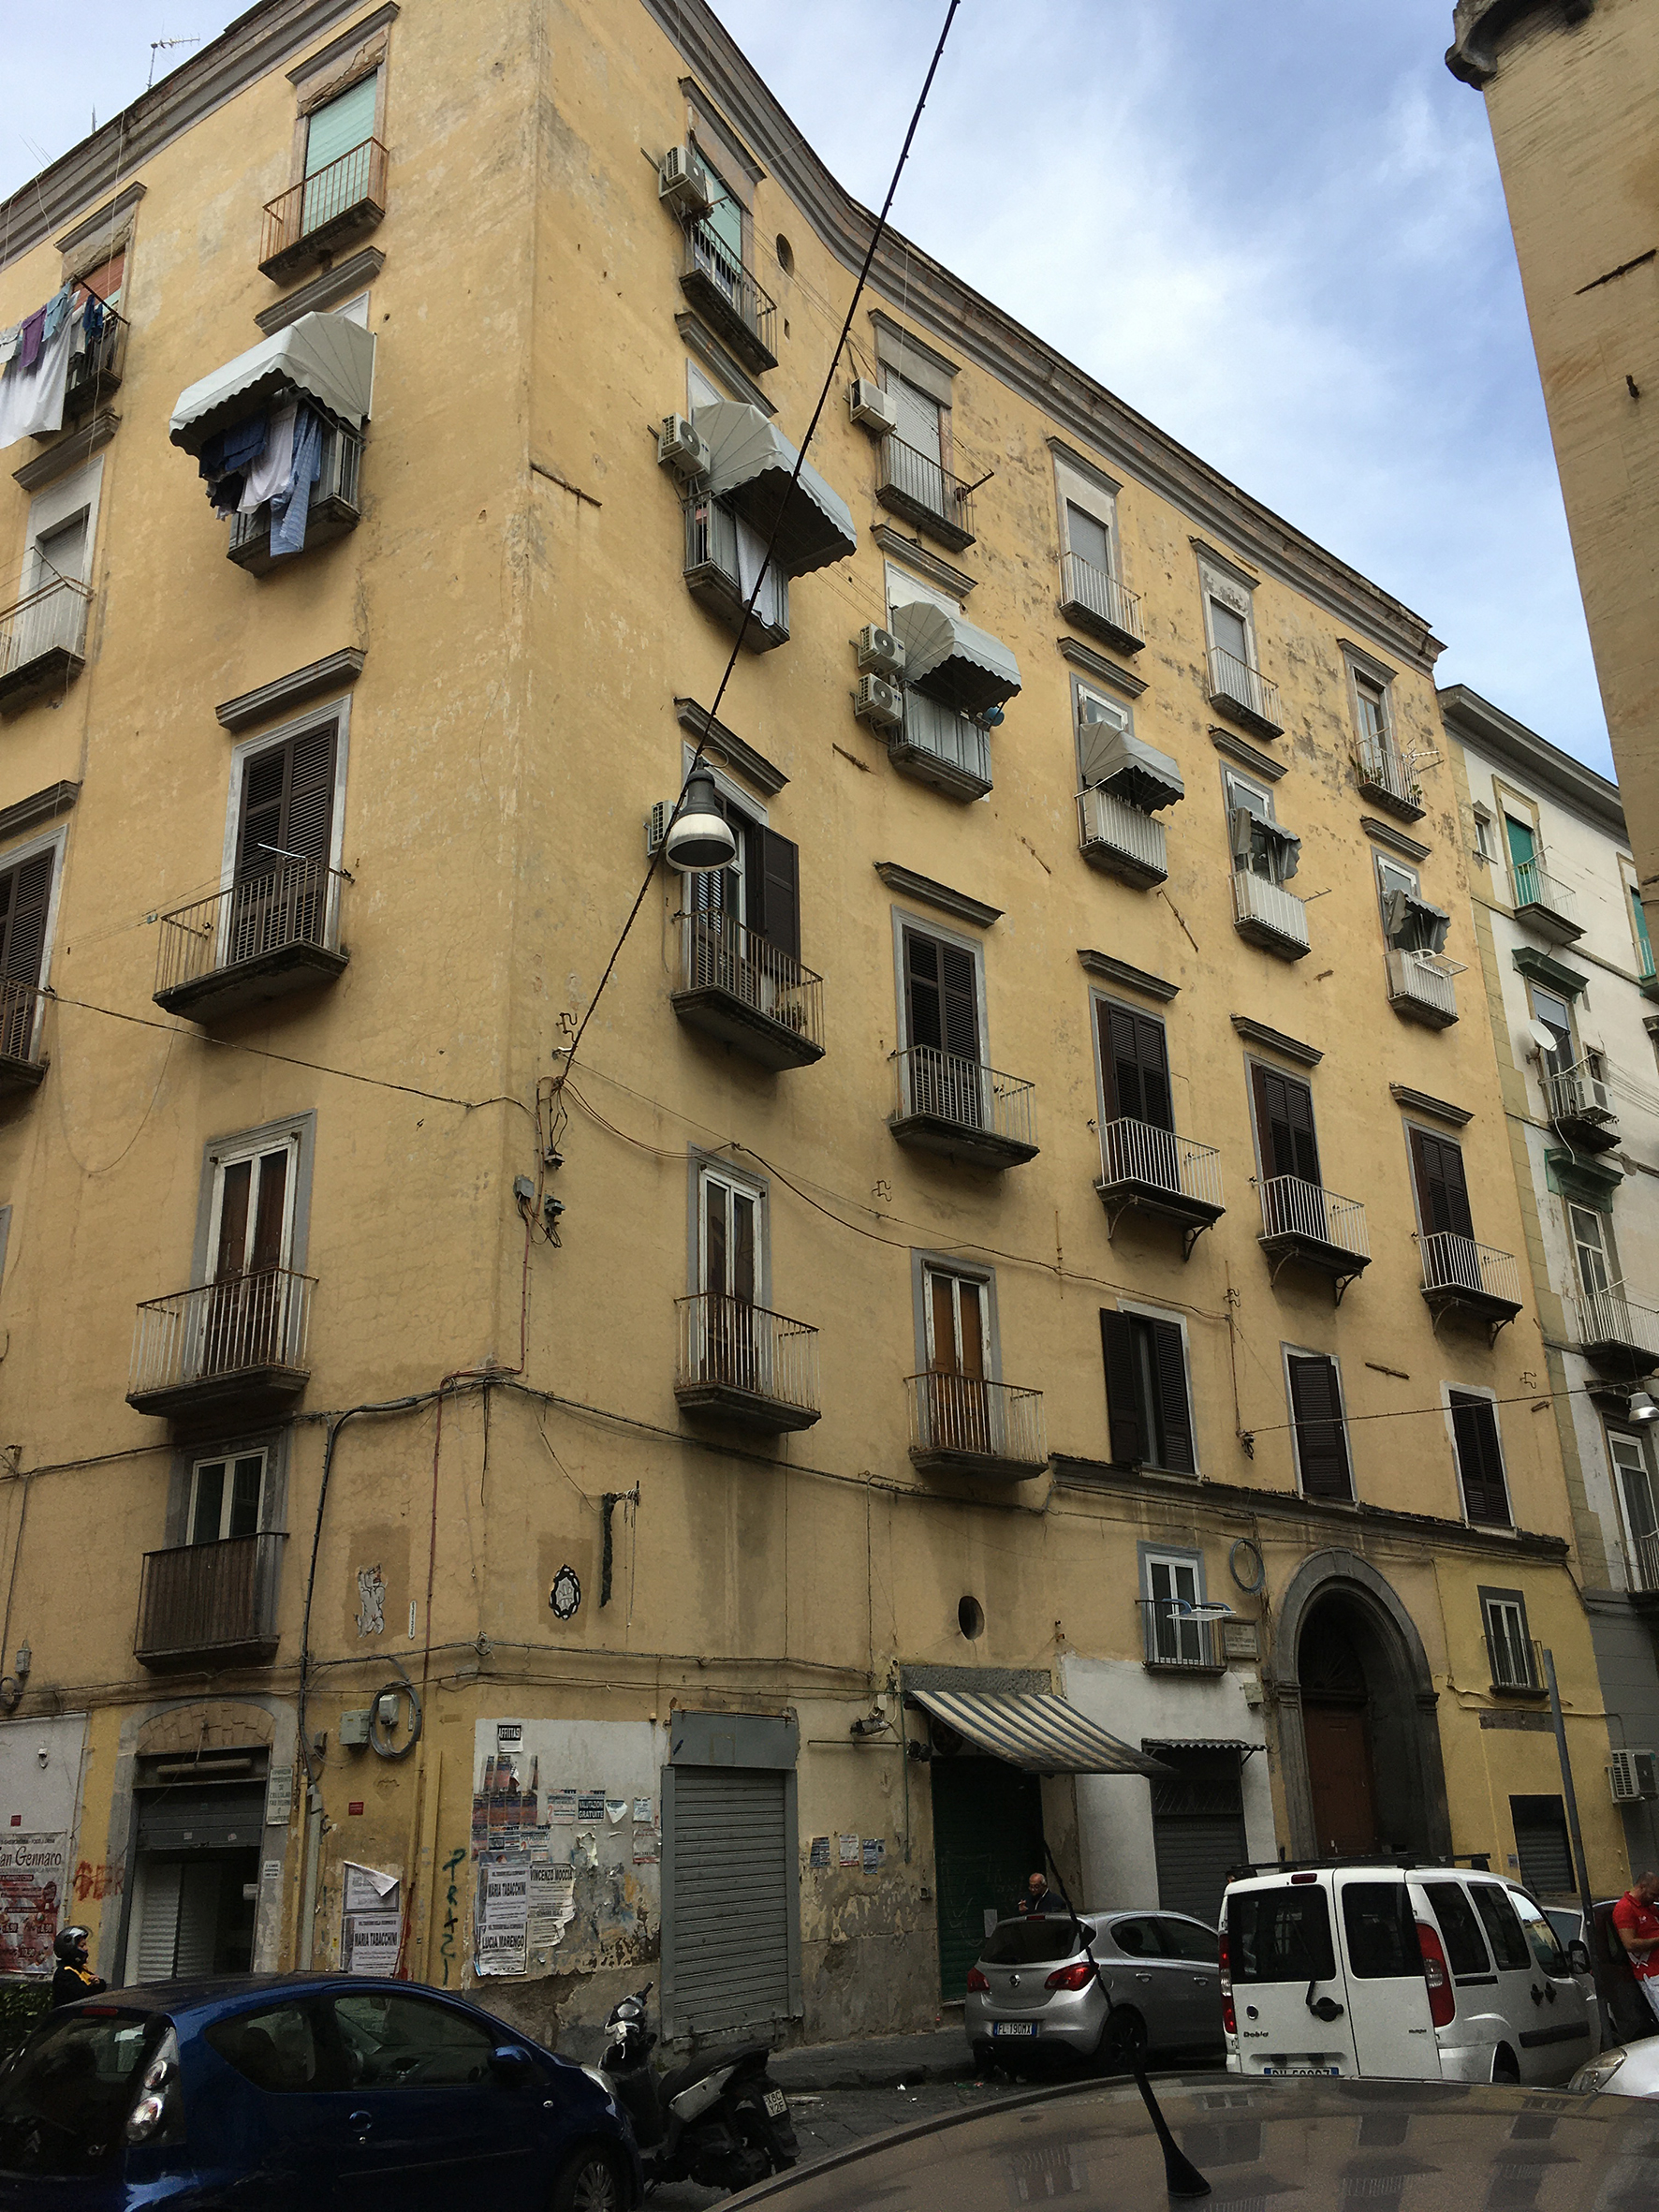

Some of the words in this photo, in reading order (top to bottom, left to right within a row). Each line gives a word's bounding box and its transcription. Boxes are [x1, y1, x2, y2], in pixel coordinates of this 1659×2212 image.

[0, 1847, 12, 1866] an
[16, 1846, 62, 1866] Gennaro
[530, 1869, 553, 1881] VINCENZO
[355, 1932, 369, 1946] MARIA
[370, 1932, 398, 1946] TABACCHINI
[482, 1936, 498, 1949] LUCIA
[499, 1935, 524, 1948] MARENGO
[766, 2091, 782, 2104] X8C
